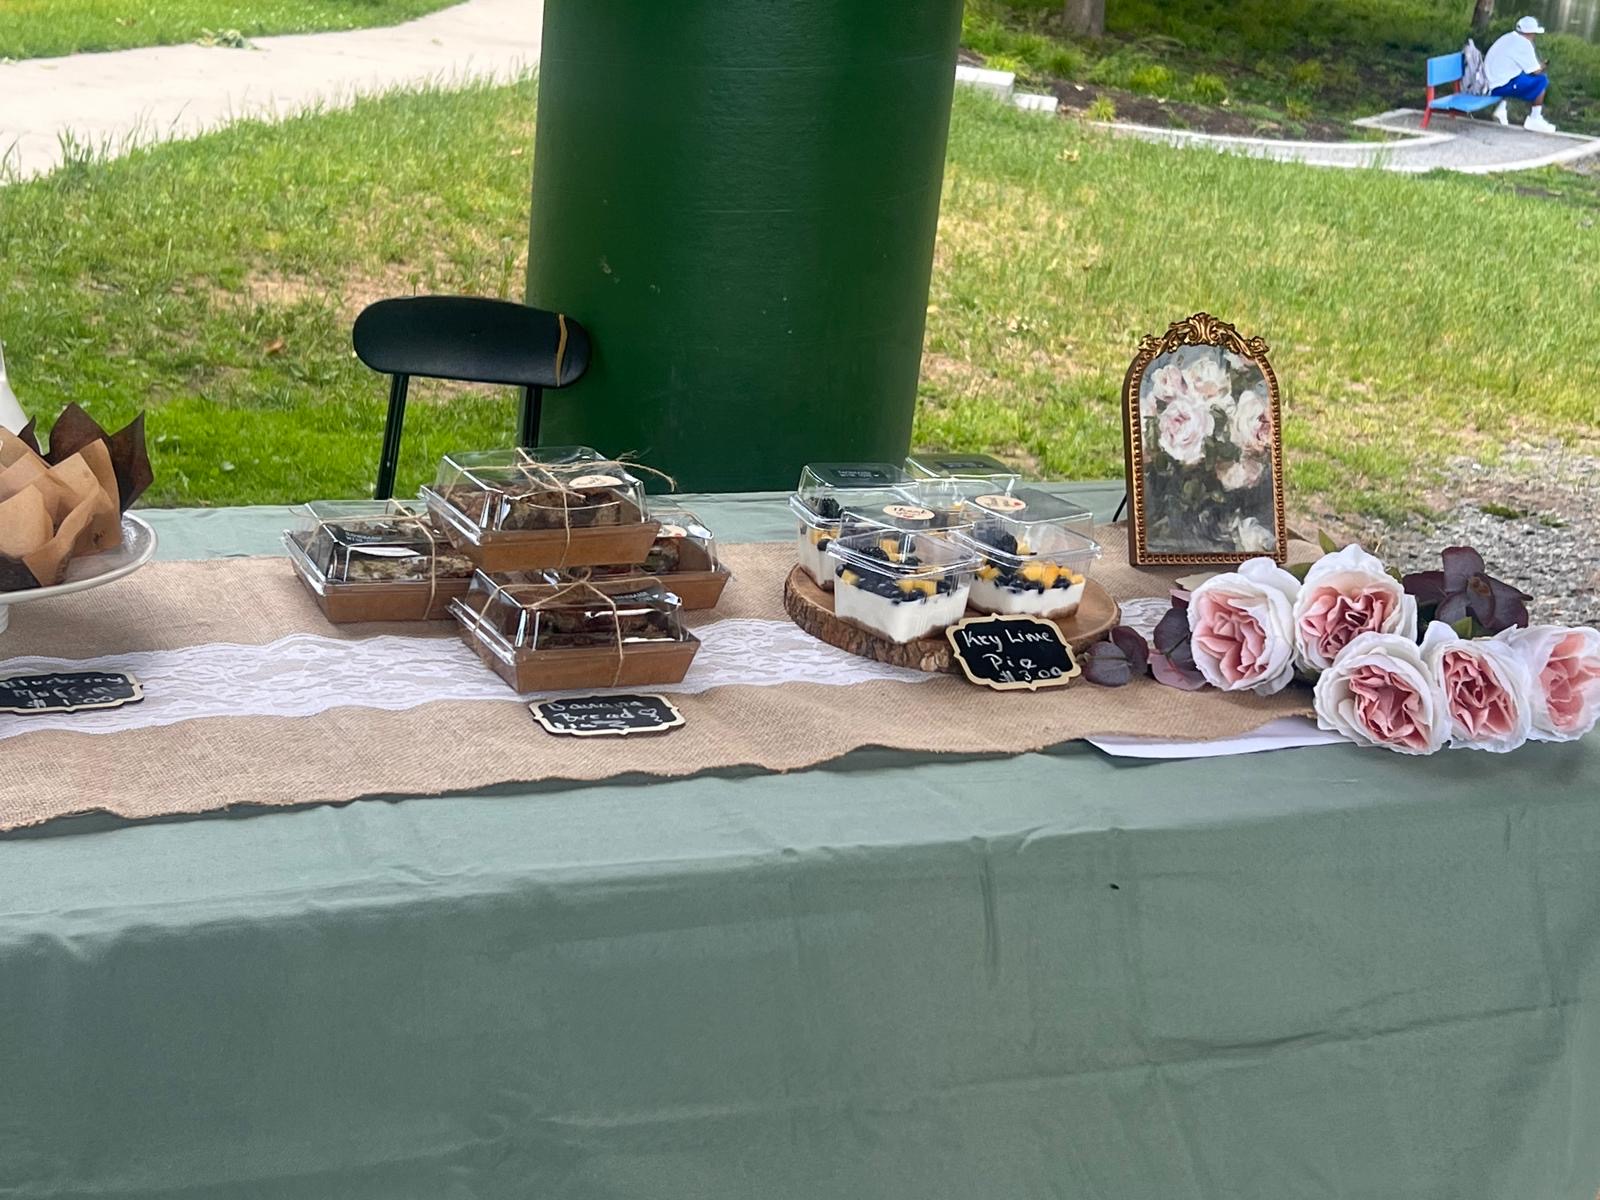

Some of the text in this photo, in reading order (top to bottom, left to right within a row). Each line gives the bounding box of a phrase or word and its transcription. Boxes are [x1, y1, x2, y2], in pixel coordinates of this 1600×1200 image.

[961, 628, 1054, 652] Key Lime
[982, 653, 1037, 671] Pie
[553, 708, 635, 722] Bread
